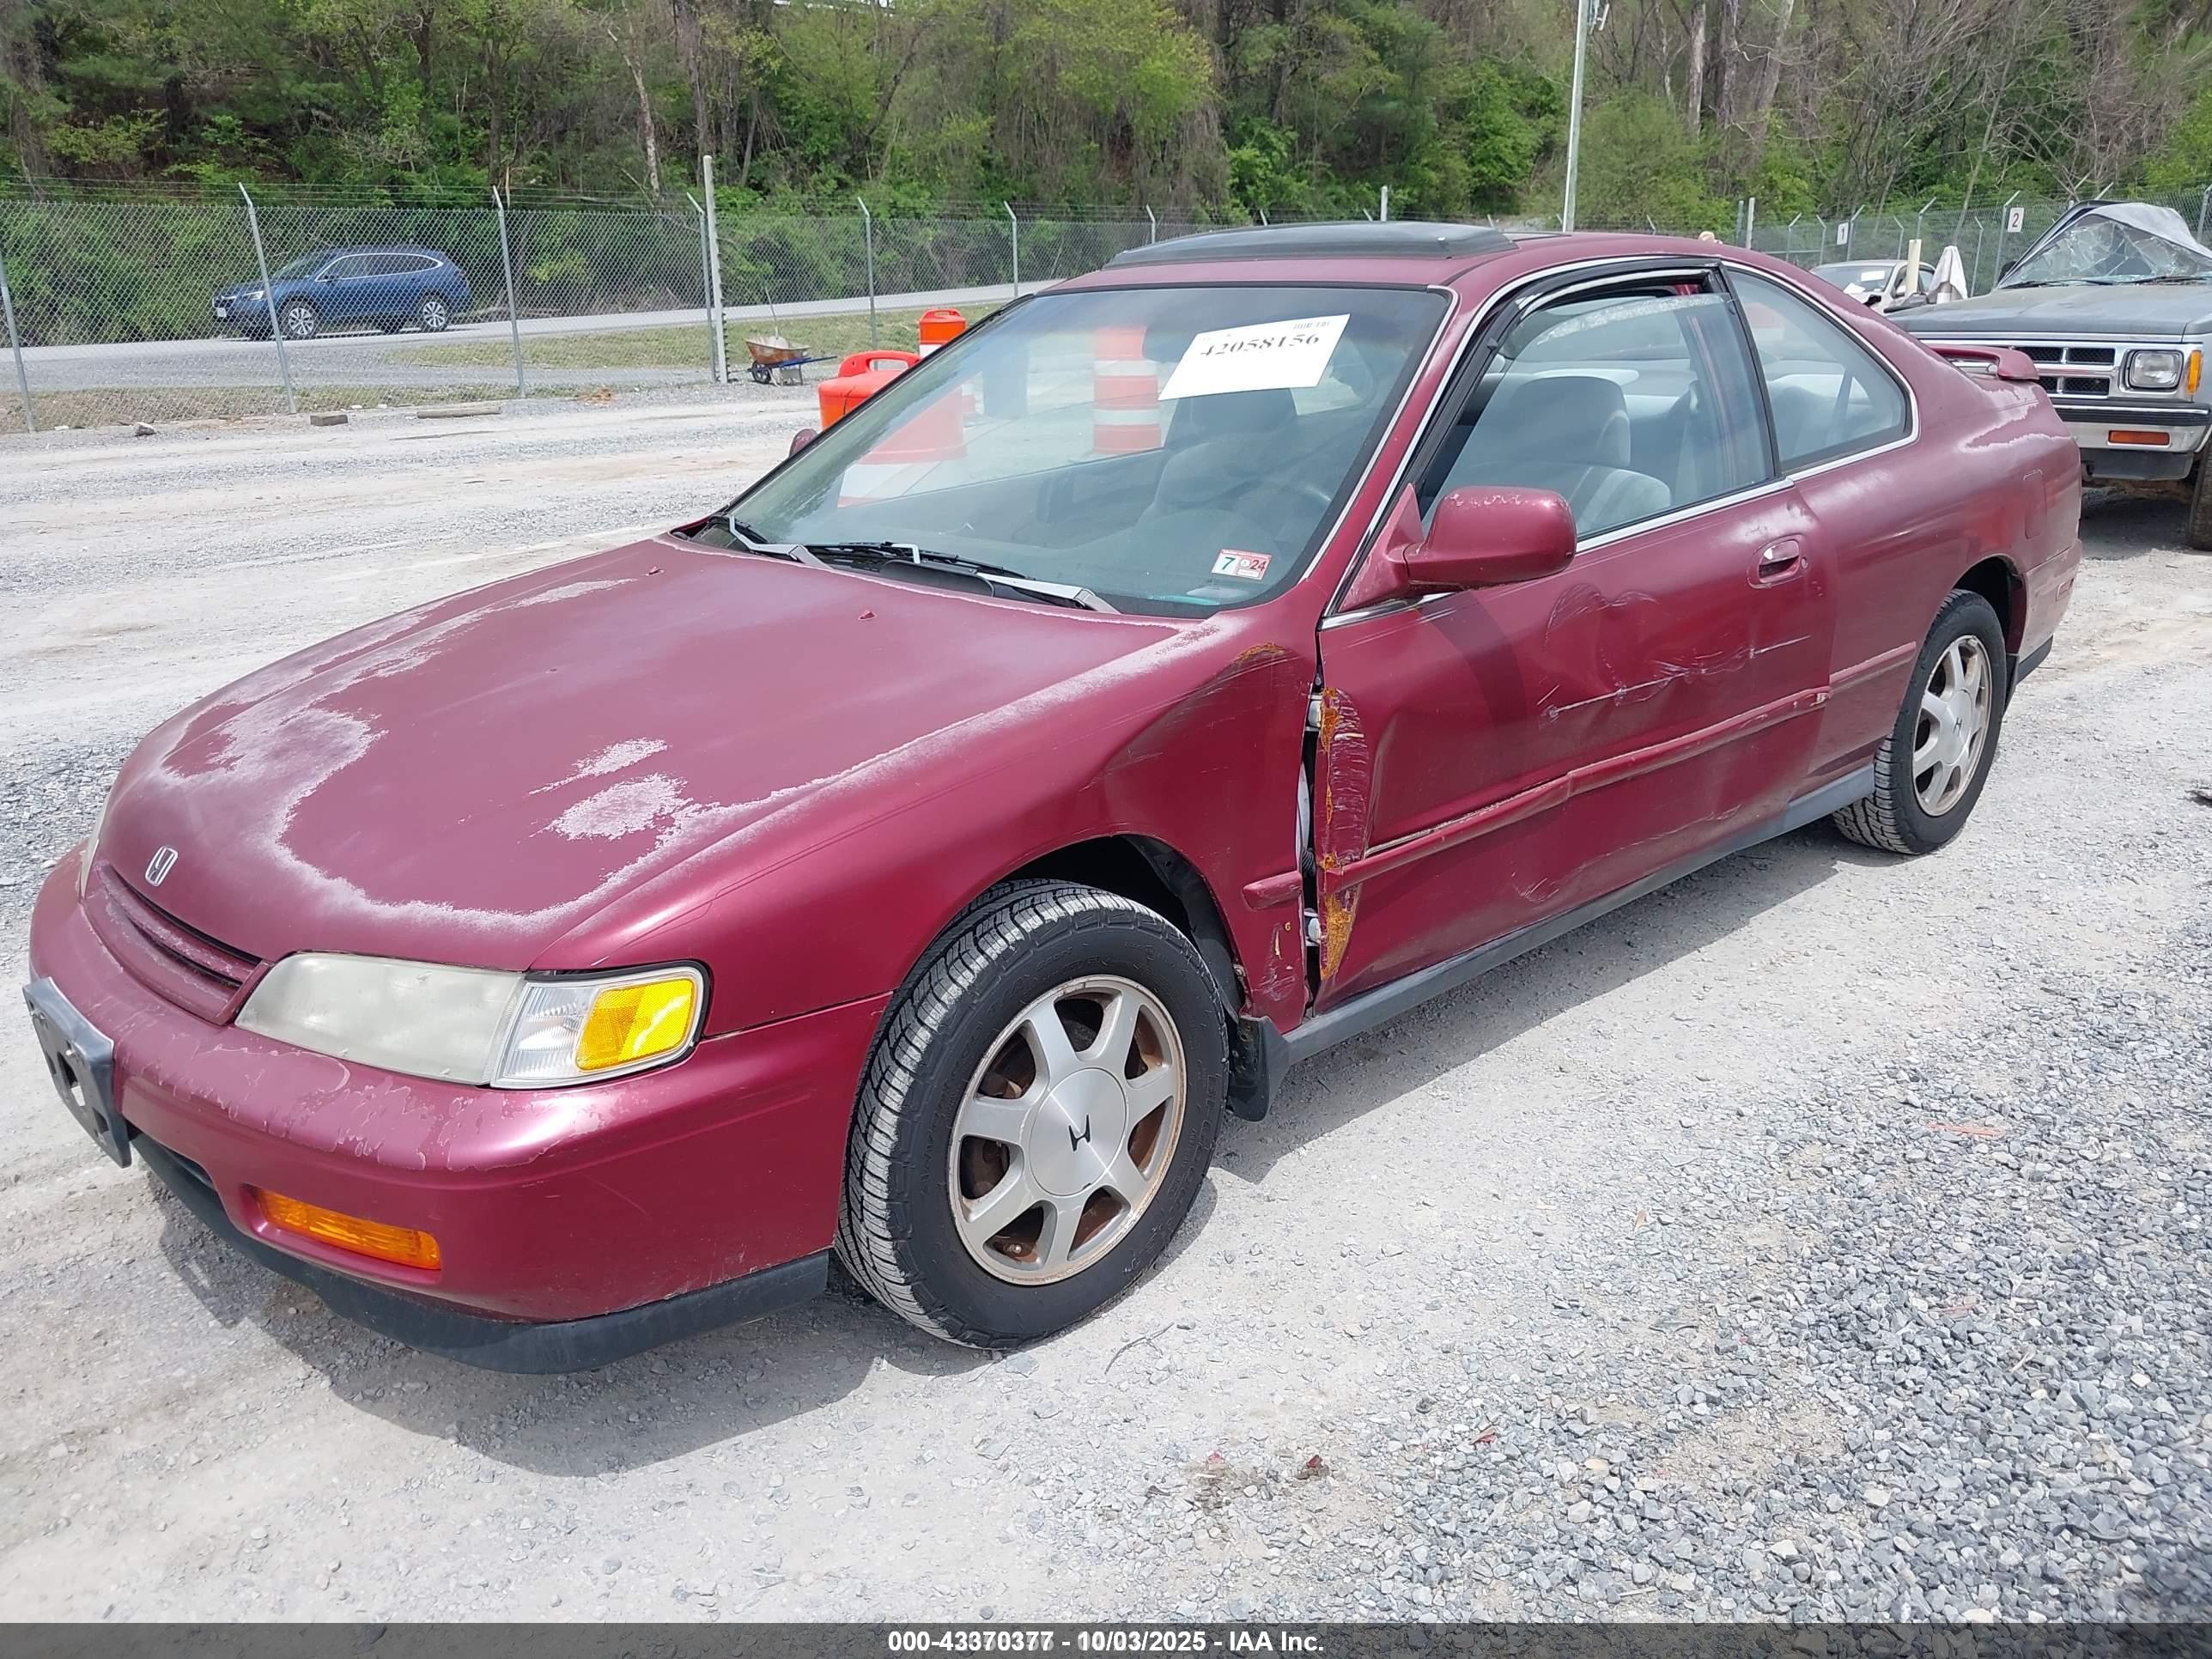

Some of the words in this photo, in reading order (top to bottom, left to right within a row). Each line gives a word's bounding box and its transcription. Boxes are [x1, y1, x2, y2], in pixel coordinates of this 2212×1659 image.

[2012, 212, 2020, 228] 2
[1200, 333, 1320, 356] 42058156
[1221, 556, 1237, 571] 7
[1249, 559, 1267, 572] 24
